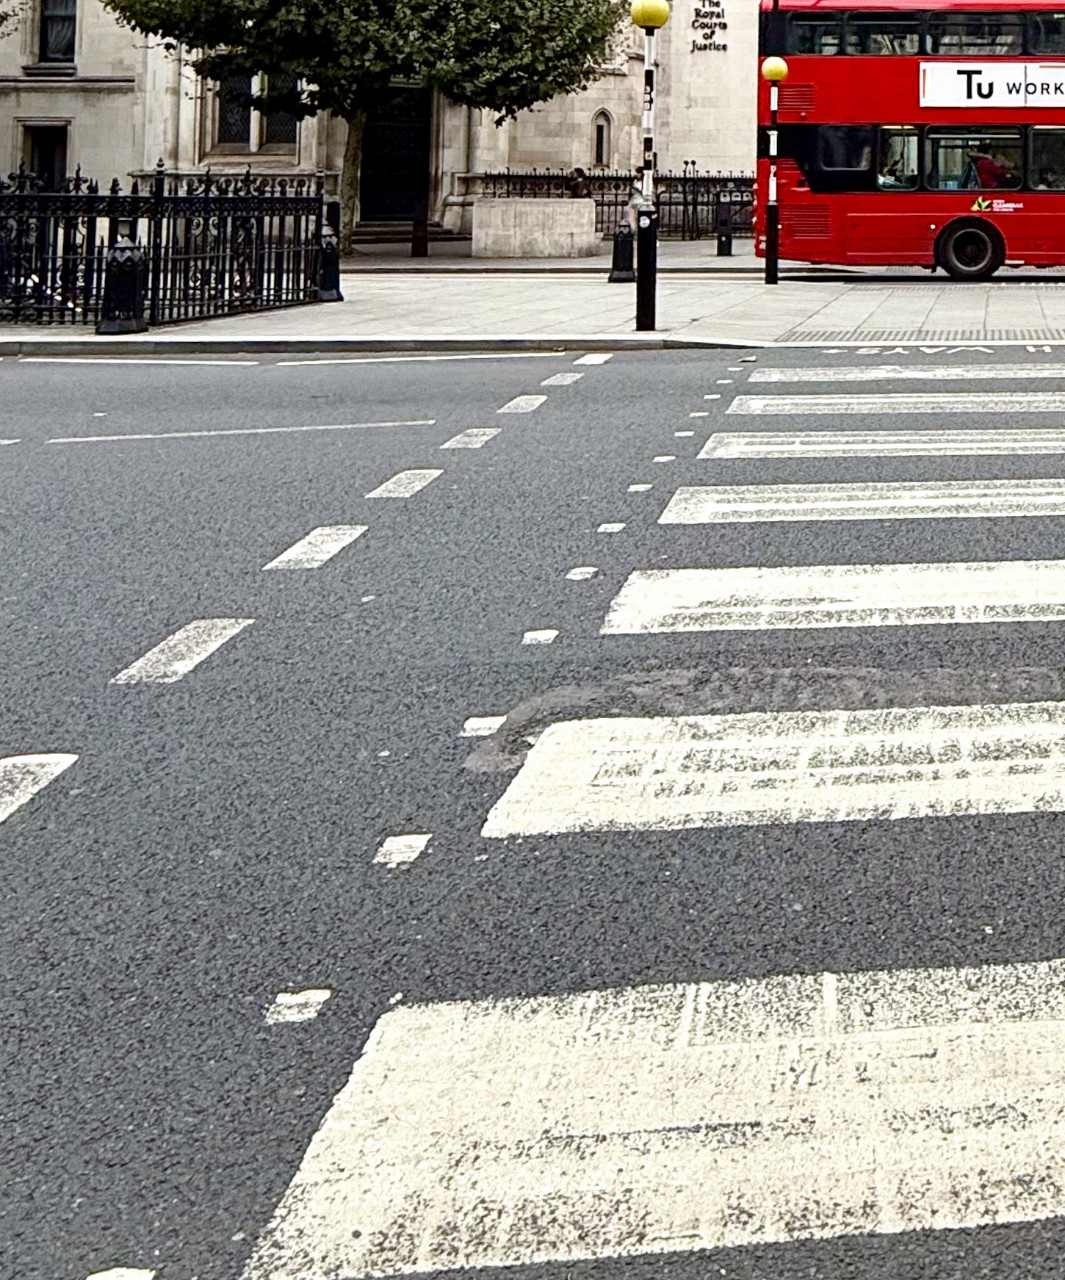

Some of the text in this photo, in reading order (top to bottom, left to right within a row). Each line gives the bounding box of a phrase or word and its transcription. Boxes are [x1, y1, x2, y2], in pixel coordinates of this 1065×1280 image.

[694, 8, 725, 20] Royal
[691, 19, 728, 30] Courts
[702, 30, 716, 40] of
[690, 40, 728, 54] Justice
[855, 346, 995, 354] WAYS
